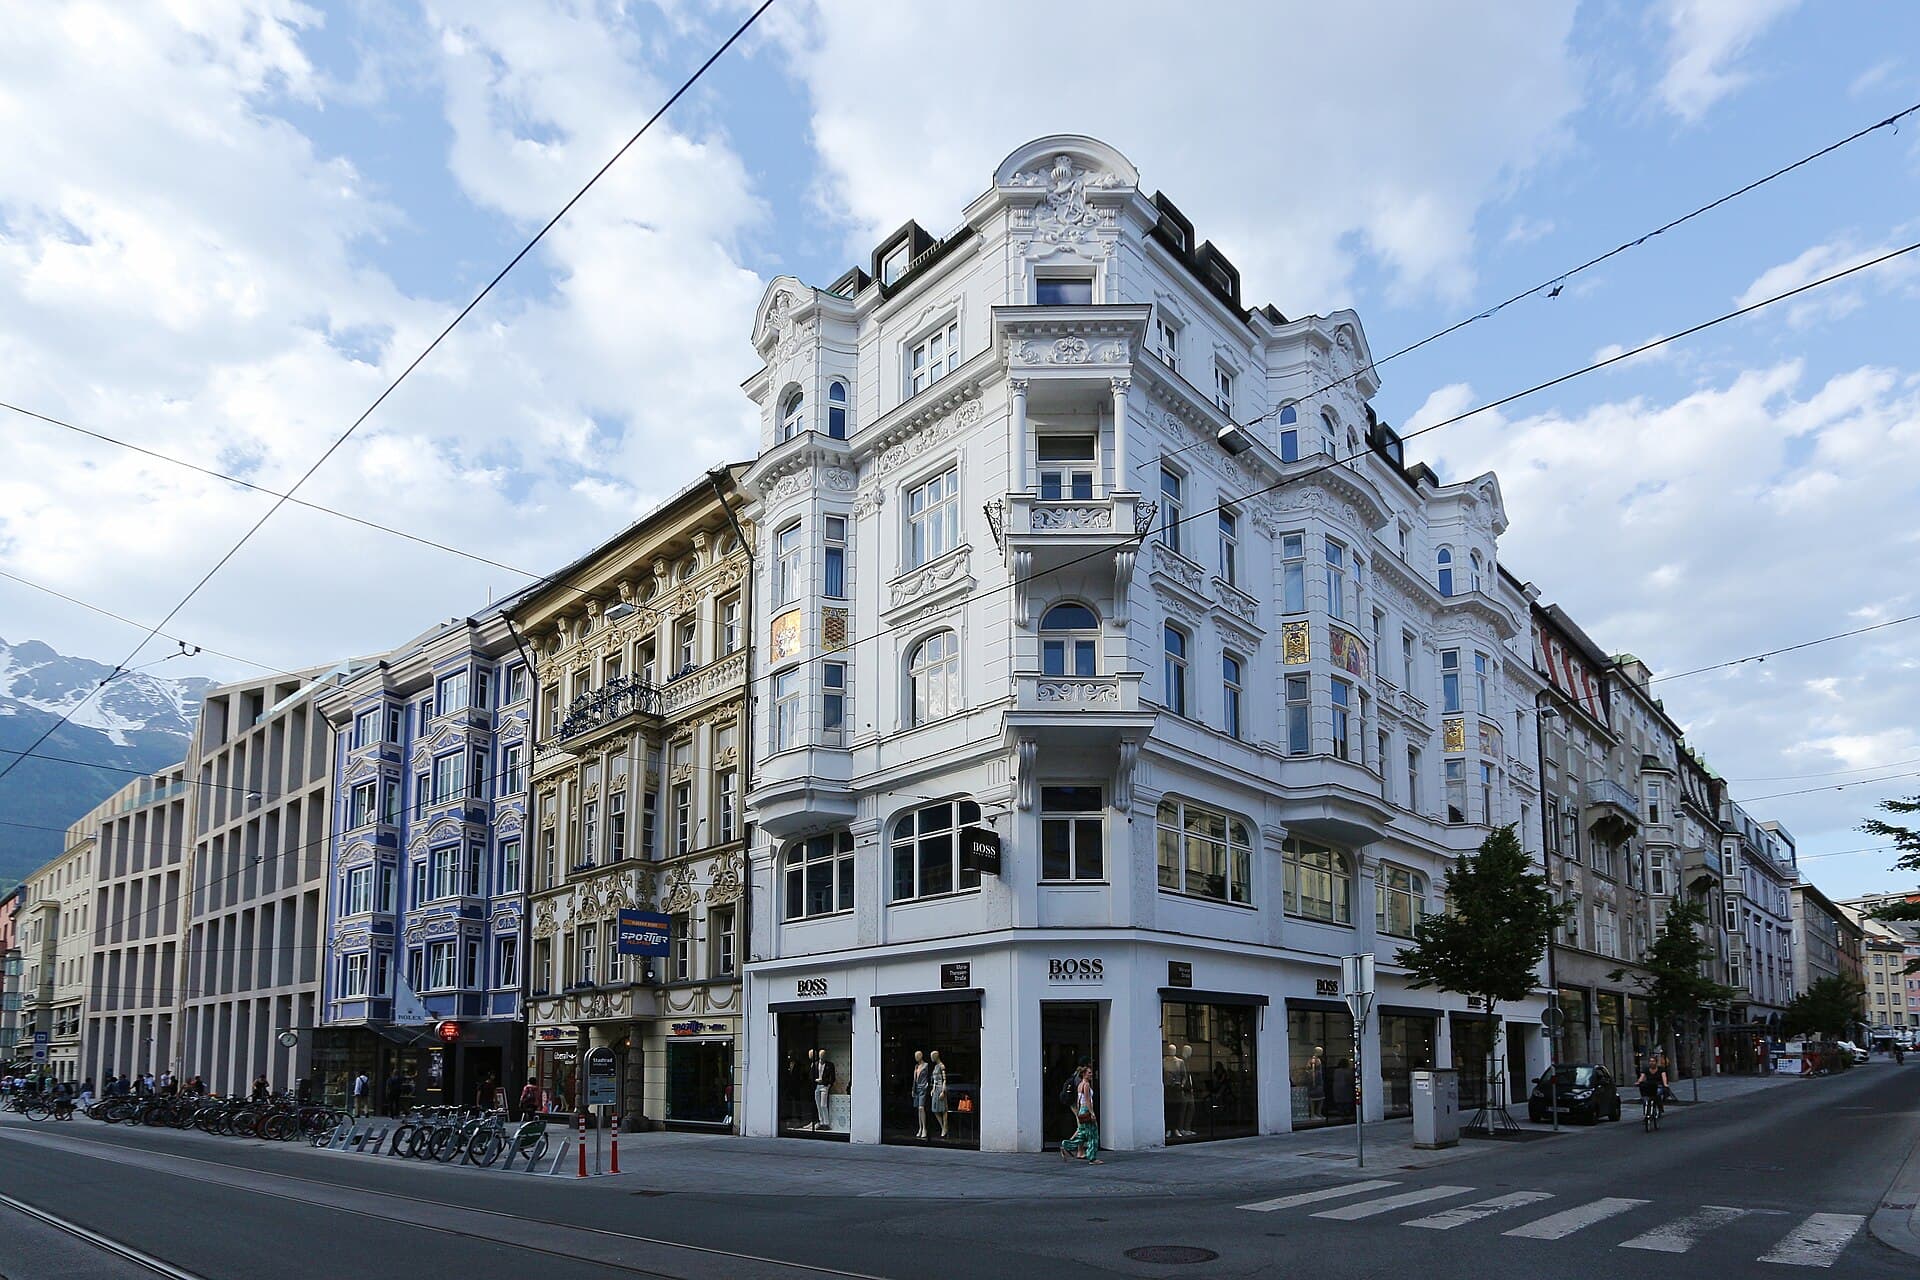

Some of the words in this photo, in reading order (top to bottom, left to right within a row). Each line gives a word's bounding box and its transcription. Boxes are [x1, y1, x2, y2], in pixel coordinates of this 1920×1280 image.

[973, 841, 996, 855] BOSS
[620, 931, 668, 945] SPORTLER
[1049, 958, 1104, 974] BOSS
[797, 977, 827, 992] BOSS
[1316, 978, 1338, 992] BOSS
